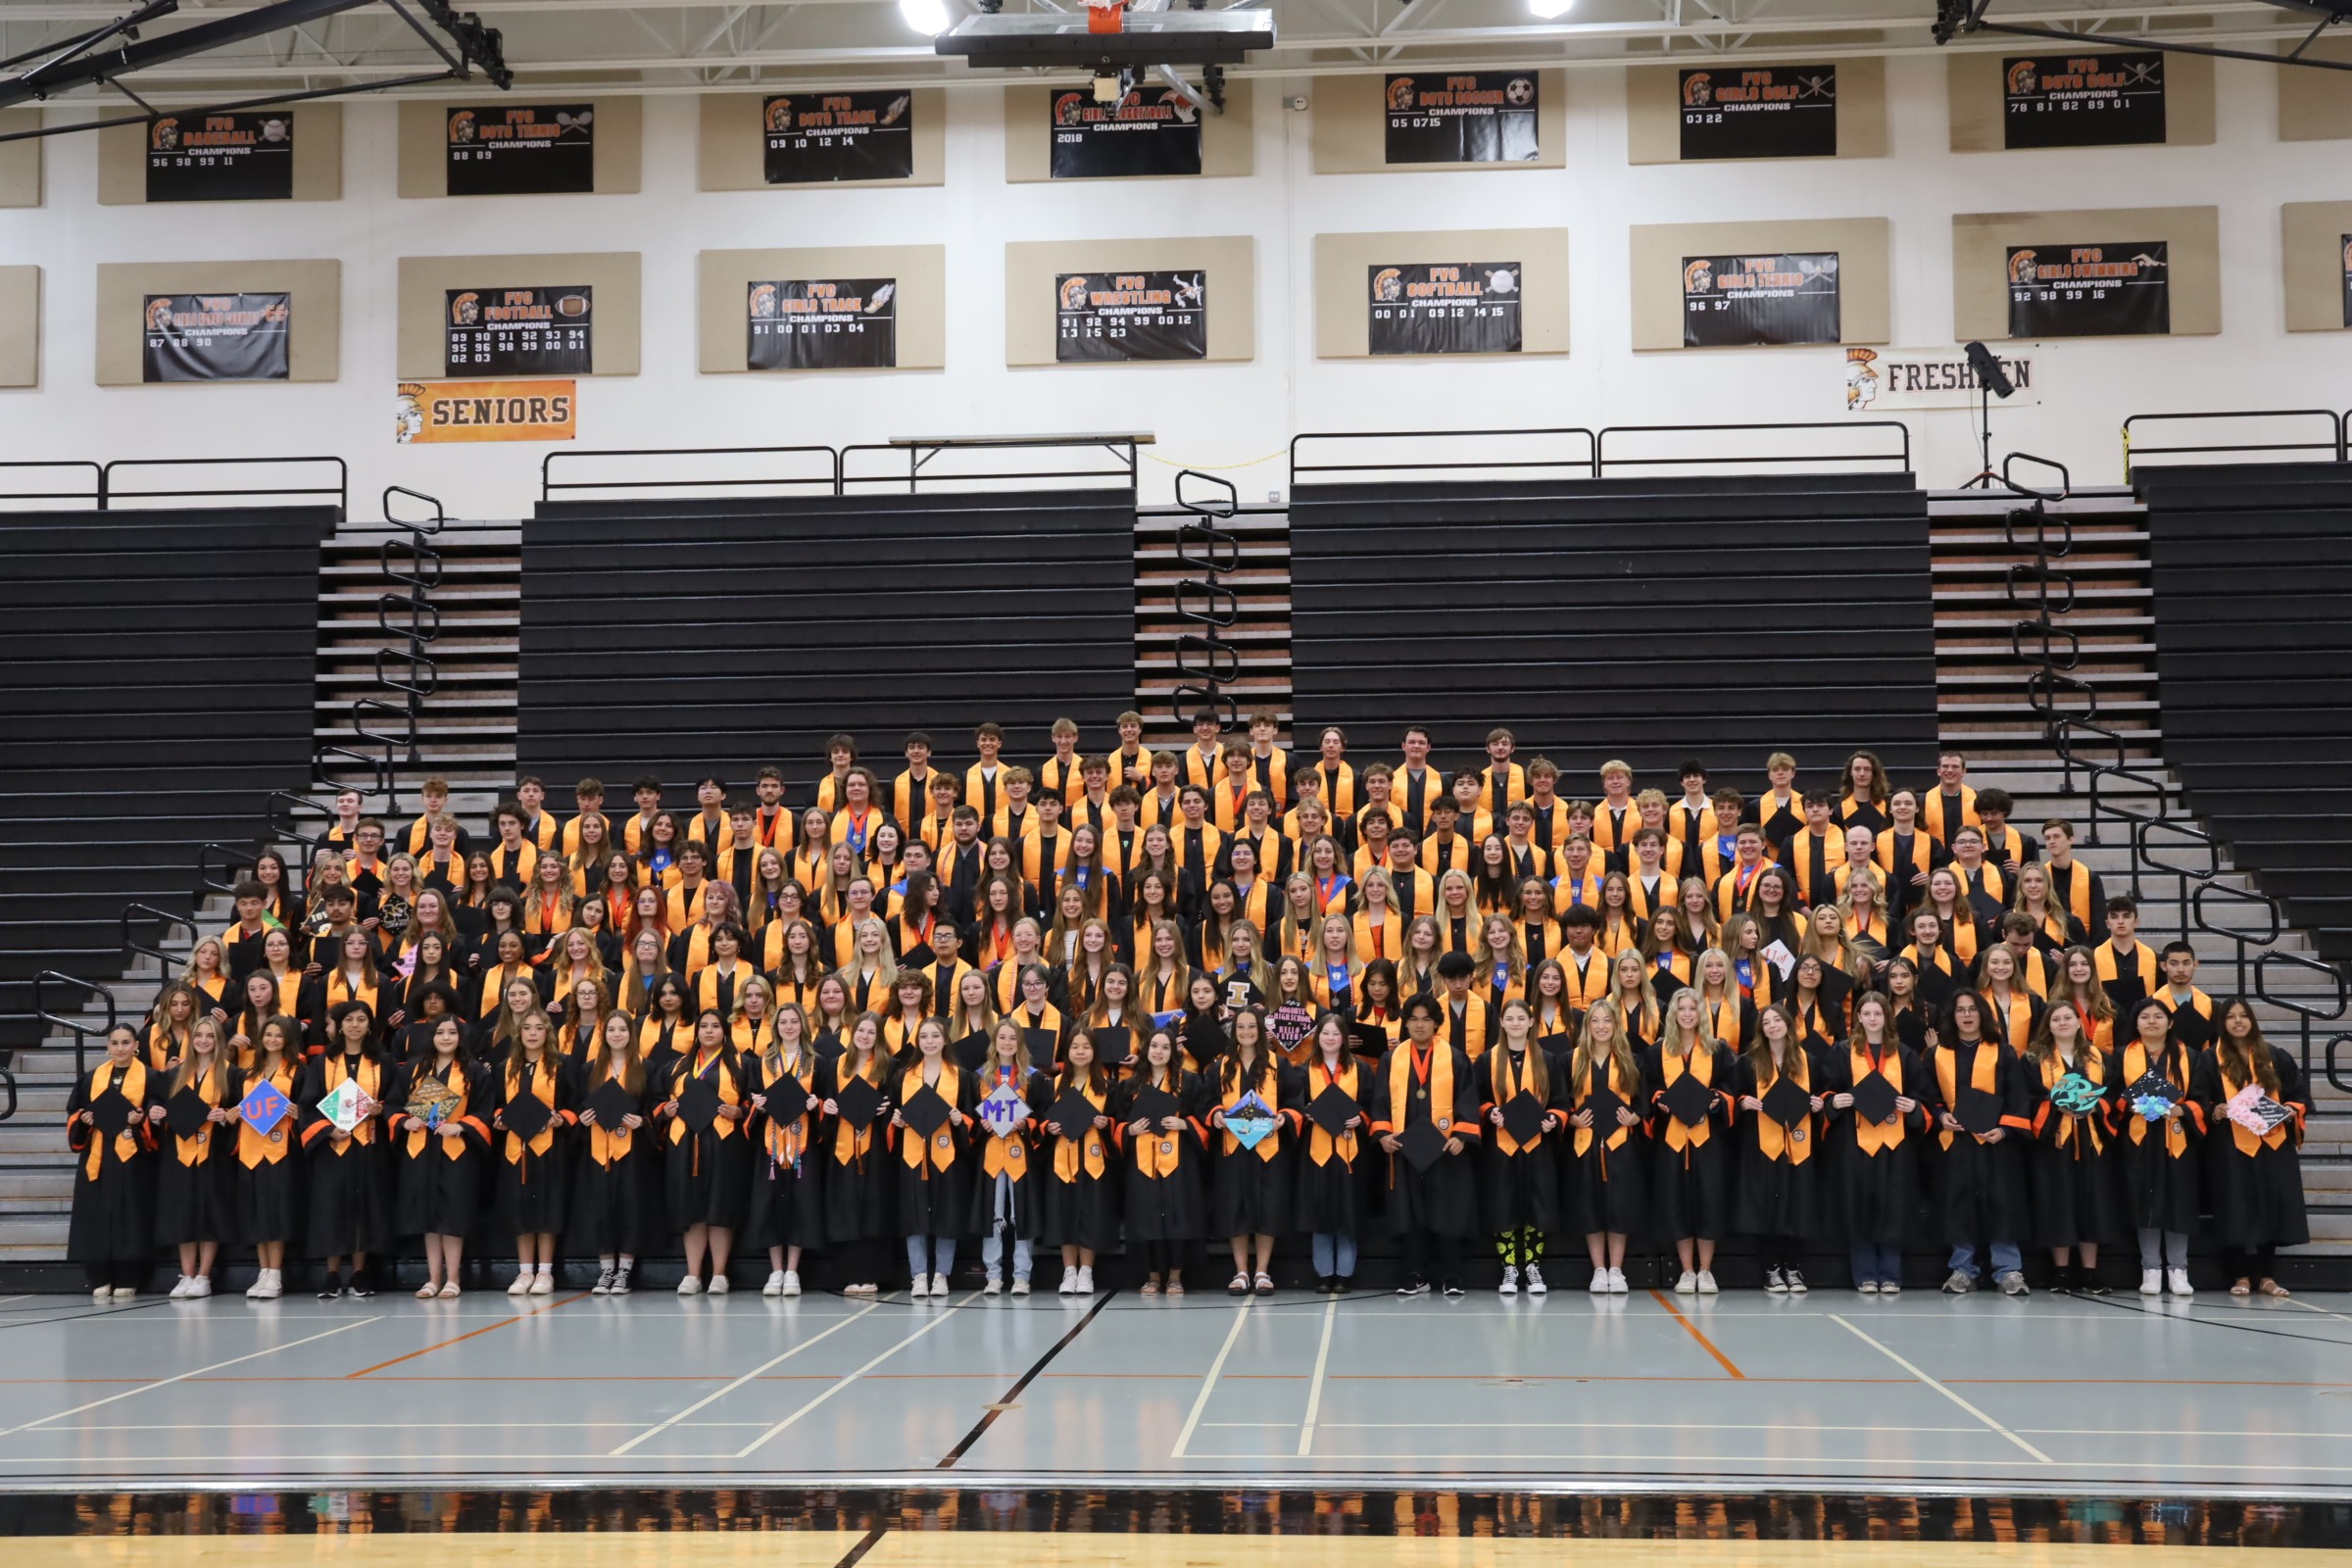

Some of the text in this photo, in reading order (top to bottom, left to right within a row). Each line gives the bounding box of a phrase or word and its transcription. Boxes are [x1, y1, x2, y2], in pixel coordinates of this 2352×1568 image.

[2042, 73, 2126, 89] BOYS GOLF
[1420, 90, 1504, 106] BOYS SOCCER
[1716, 85, 1799, 102] GIRLS GOLF
[2049, 90, 2119, 100] CHAMPIONS
[1724, 103, 1790, 112] CHAMPIONS
[2011, 99, 2130, 113] 78 81 82 89 01
[206, 117, 234, 130] FVC
[799, 110, 876, 126] BOYS TRACK
[1392, 119, 1407, 127] 05
[1687, 114, 1722, 123] 03 22
[480, 123, 561, 139] BOYS TENNIS
[806, 127, 869, 136] CHAMPIONS
[1094, 122, 1158, 131] CHAMPIONS
[183, 131, 257, 146] BASEBALL
[488, 140, 552, 149] CHAMPIONS
[770, 136, 854, 149] 09 10 12 14
[1057, 133, 1082, 143] 2018
[454, 151, 468, 160] 88
[153, 158, 168, 167] 96
[176, 158, 191, 167] 98
[2071, 248, 2102, 263] FVC
[1745, 259, 1775, 272] FVC
[2037, 262, 2137, 278] GIRLS SWIMMING
[1430, 268, 1459, 282] FVC
[1718, 272, 1803, 288] GIRLS TENNIS
[1116, 276, 1146, 290] FVC
[1407, 281, 1483, 297] SOFTBALL
[2053, 280, 2122, 289] CHAMPIONS
[808, 283, 837, 298] FVC
[1727, 290, 1794, 299] CHAMPIONS
[2015, 290, 2105, 302] 92 98 99 16
[505, 291, 533, 306] FVC
[1091, 290, 1171, 306] WRESTLING
[782, 298, 861, 313] GIRLS TRACK
[1099, 307, 1162, 316] CHAMPIONS
[1690, 301, 1731, 311] 96 97
[485, 306, 553, 320] FOOTBALL
[1375, 310, 1391, 318] 00
[1429, 309, 1445, 318] 09
[1450, 308, 1464, 318] 12
[1474, 308, 1486, 317] 14
[1492, 307, 1503, 316] 15
[487, 321, 550, 330] CHAMPIONS
[1062, 318, 1078, 327] 91
[1086, 318, 1102, 326] 92
[1135, 317, 1150, 325] 99
[1158, 316, 1174, 324] 00
[1178, 316, 1192, 324] 12
[755, 325, 768, 334] 91
[802, 324, 816, 333] 01
[849, 323, 864, 332] 04
[1086, 328, 1102, 337] 15
[1110, 328, 1126, 337] 23
[173, 338, 188, 347] 88
[452, 333, 466, 342] 89
[499, 332, 514, 341] 91
[522, 331, 537, 340] 92
[569, 330, 584, 339] 94
[475, 343, 490, 352] 96
[522, 342, 537, 351] 99
[546, 341, 561, 350] 00
[1888, 360, 2031, 392] FRESHEN
[432, 397, 569, 425] SENIORS
[1226, 981, 1250, 1007] I
[246, 1097, 278, 1119] UF
[983, 1100, 1018, 1122] MT
